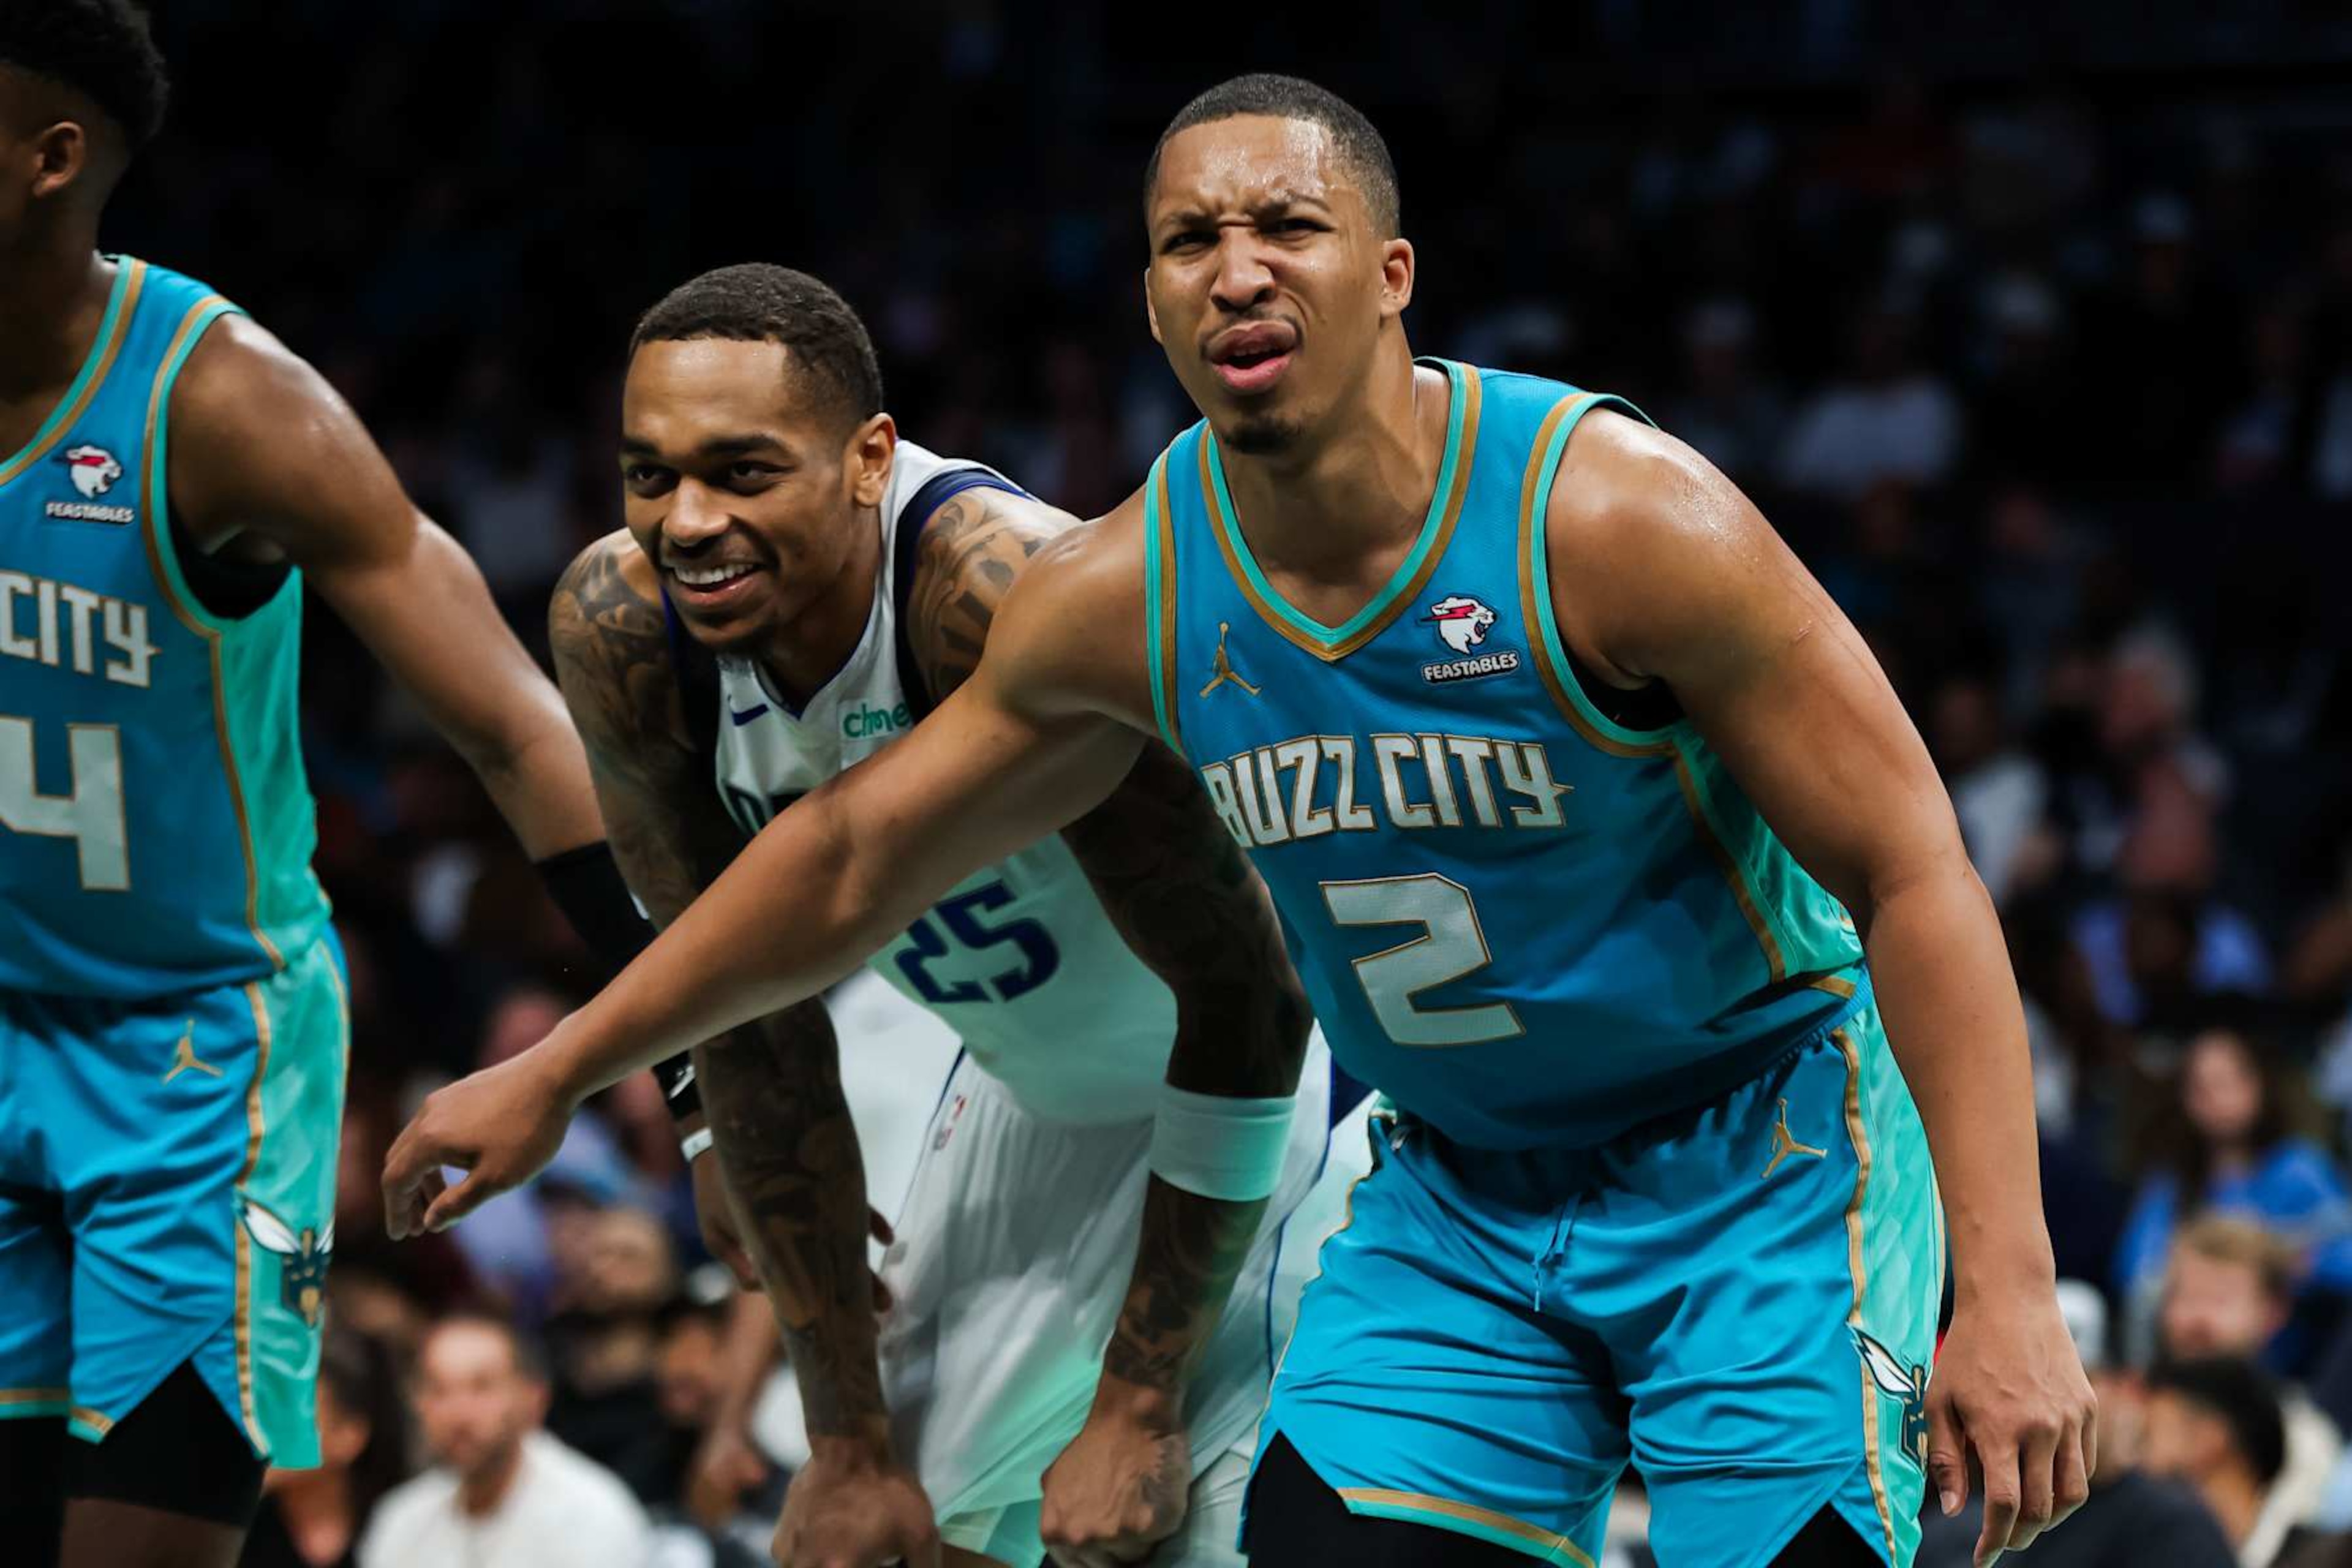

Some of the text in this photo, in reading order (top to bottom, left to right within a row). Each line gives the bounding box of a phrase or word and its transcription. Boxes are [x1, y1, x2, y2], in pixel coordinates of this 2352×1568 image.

[46, 502, 135, 523] FEASTABLES
[0, 570, 161, 687] CITY
[1423, 653, 1518, 680] FEASTABLES
[1200, 733, 1575, 847] BUZZ CITY
[894, 878, 1060, 1003] 25
[1318, 872, 1526, 1048] 2
